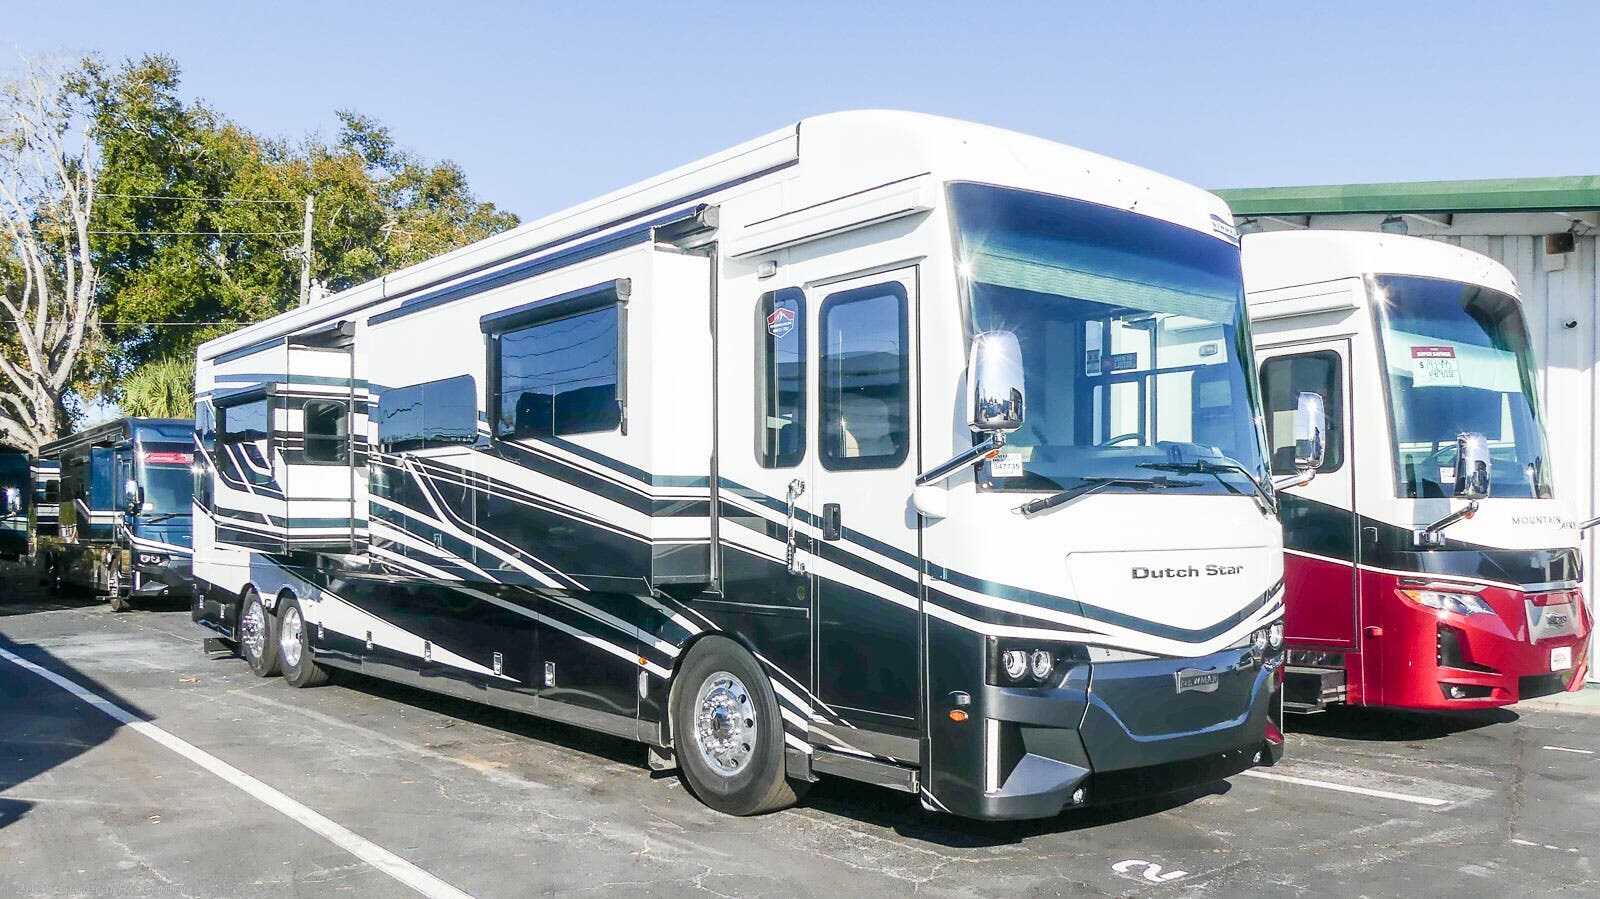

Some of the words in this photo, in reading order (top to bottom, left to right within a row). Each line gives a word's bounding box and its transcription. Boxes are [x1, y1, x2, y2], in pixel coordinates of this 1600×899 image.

[1512, 516, 1561, 525] MOUNTAIN
[1131, 565, 1200, 579] Dutch
[1205, 564, 1244, 576] Star
